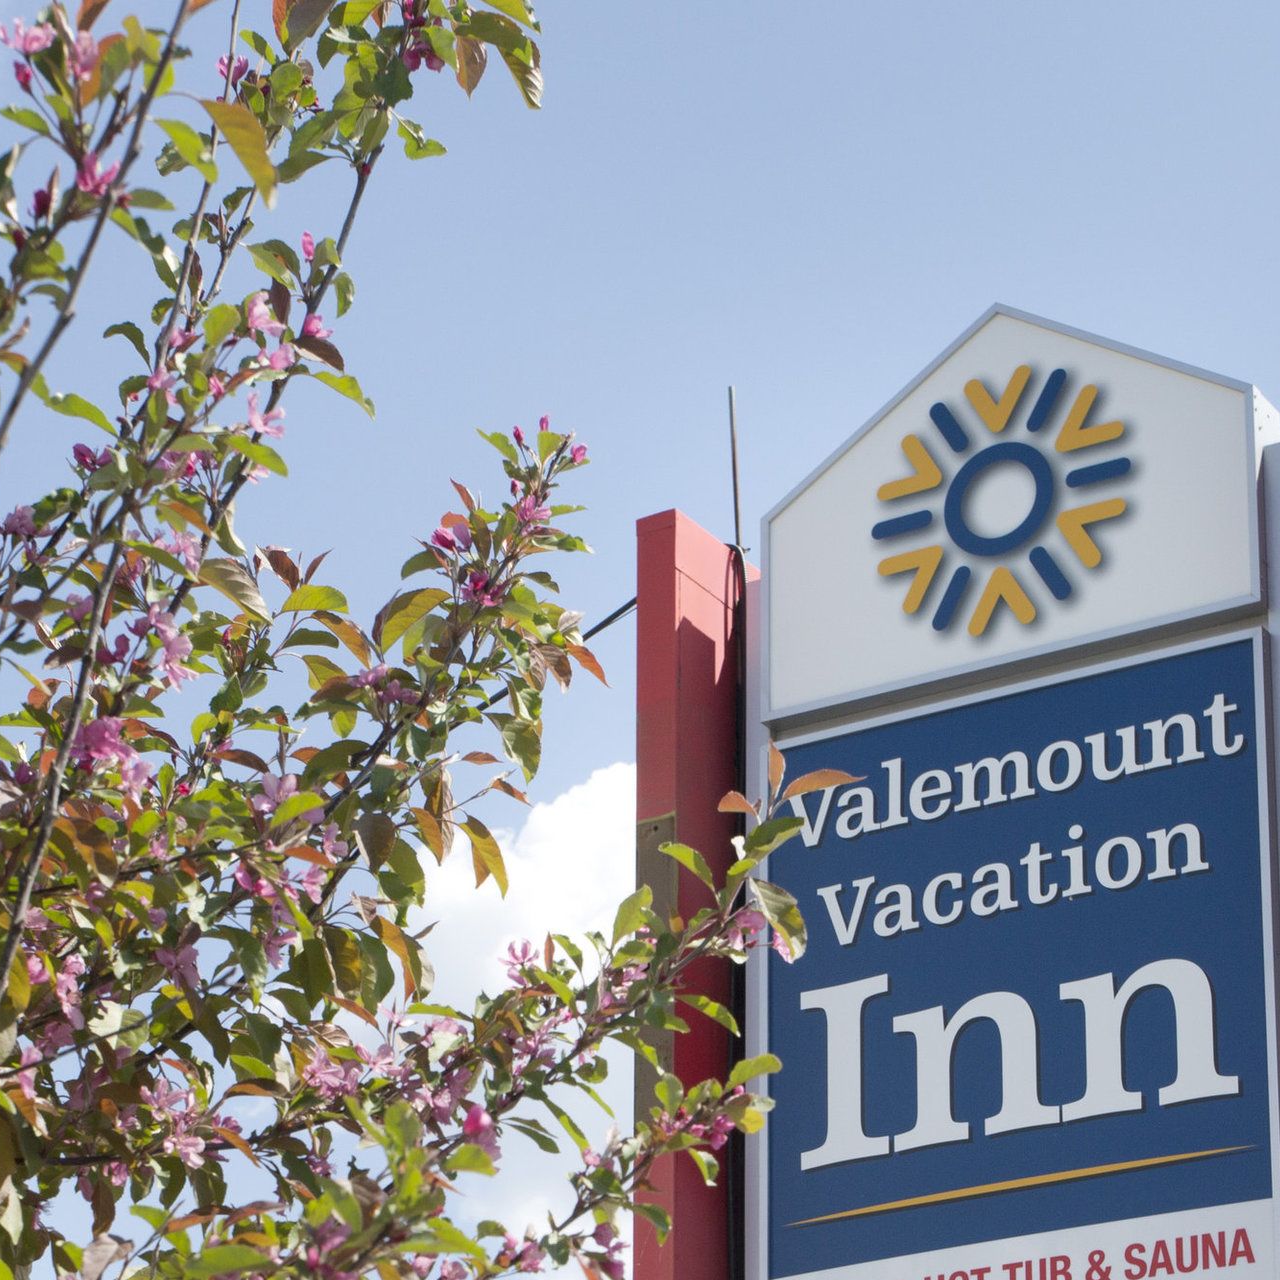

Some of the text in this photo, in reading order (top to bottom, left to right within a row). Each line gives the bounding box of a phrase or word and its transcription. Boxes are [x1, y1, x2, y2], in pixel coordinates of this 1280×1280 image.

[787, 693, 1244, 848] Valemount
[817, 820, 1209, 946] Vacation
[800, 958, 1240, 1171] Inn
[1124, 1228, 1255, 1280] SAUNA
